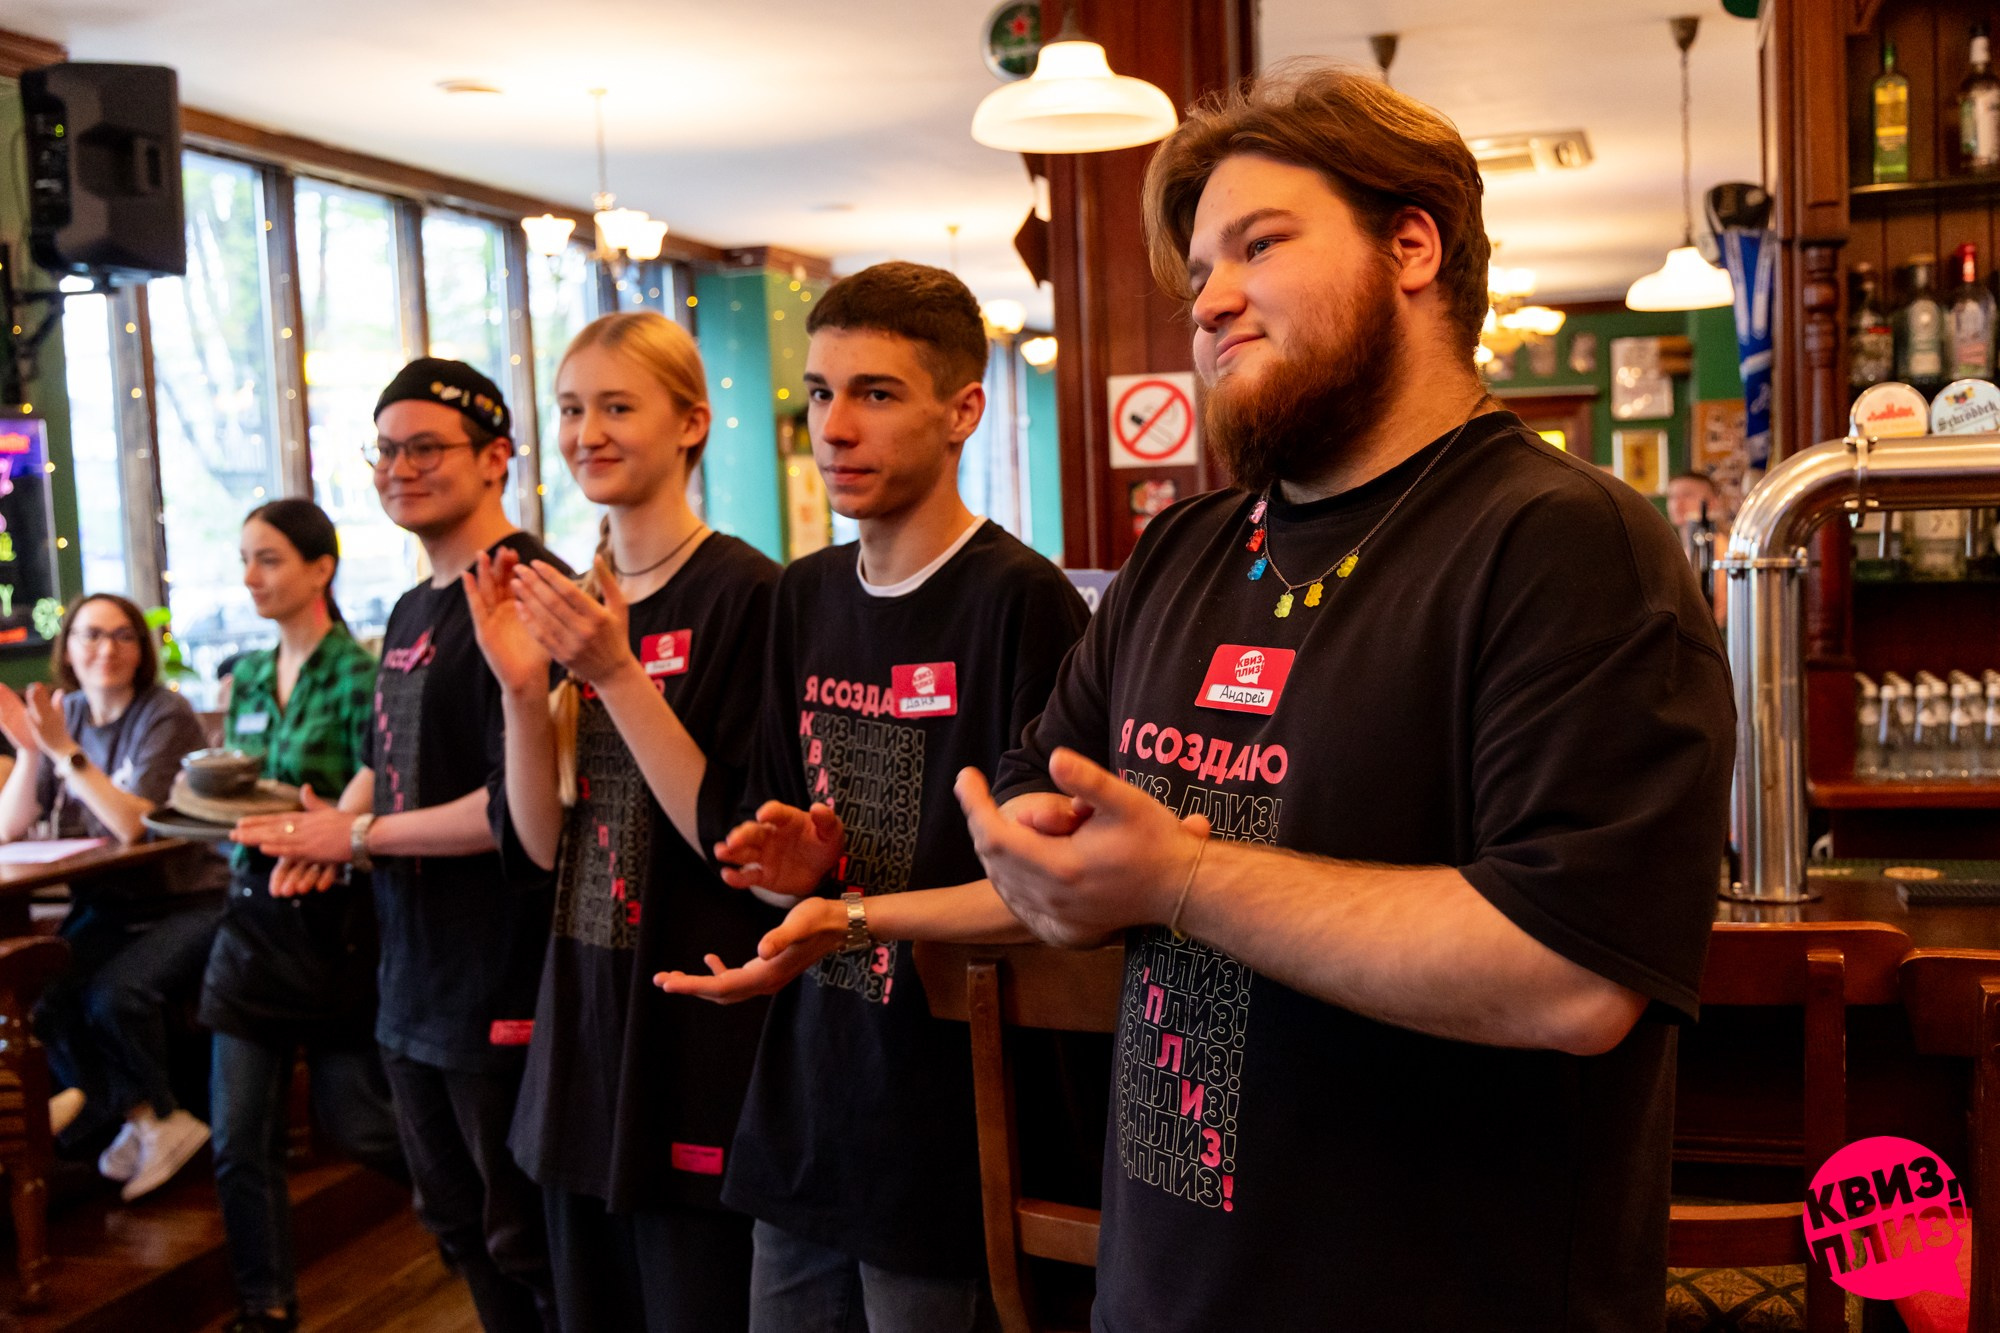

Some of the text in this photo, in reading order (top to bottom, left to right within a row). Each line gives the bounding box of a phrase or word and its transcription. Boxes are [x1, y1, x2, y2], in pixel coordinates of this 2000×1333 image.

[804, 675, 895, 718] Я СОЗДА
[1219, 685, 1265, 704] Андрей
[1118, 717, 1289, 785] Я СОЗДАЮ
[1151, 941, 1254, 1006] ПЛИЗ!
[1144, 983, 1248, 1048] ПЛИЗ!
[1140, 1022, 1244, 1092] ПЛИЗ!
[1137, 1062, 1240, 1133] ПЛИЗ!
[1135, 1101, 1237, 1173] ПЛИЗ!
[1133, 1139, 1234, 1212] ПЛИЗ!
